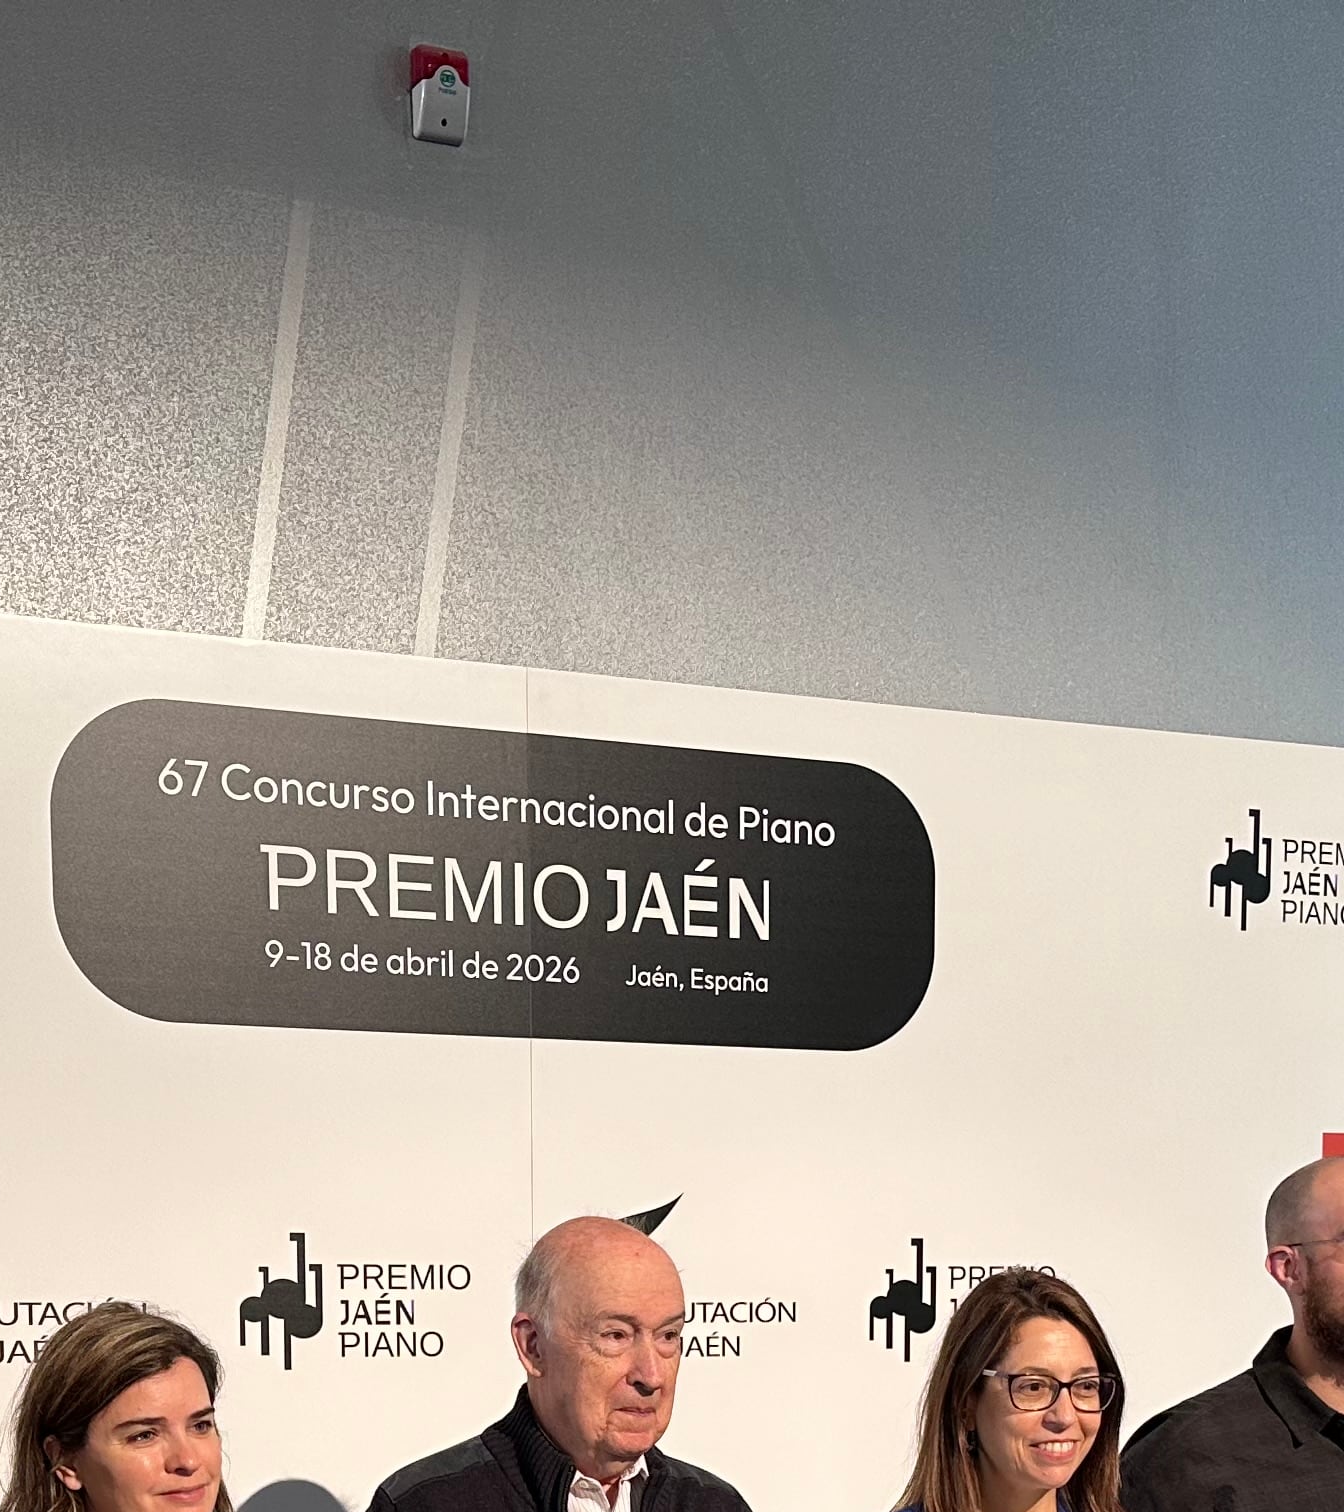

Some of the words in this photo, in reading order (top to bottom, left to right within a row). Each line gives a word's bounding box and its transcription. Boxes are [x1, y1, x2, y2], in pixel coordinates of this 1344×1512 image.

[158, 758, 209, 797] 67
[221, 763, 415, 814] Concurso
[426, 780, 675, 835] Internacional
[684, 802, 729, 839] de
[739, 806, 836, 847] Piano
[260, 844, 589, 929] PREMIO
[606, 858, 770, 941] JAÉN
[1282, 866, 1338, 897] JAÉN
[264, 939, 332, 971] 9-18
[340, 943, 378, 973] de
[386, 947, 454, 977] abril
[462, 950, 499, 980] de
[506, 953, 580, 983] 2026
[625, 964, 684, 991] Jaén,
[690, 967, 769, 996] España
[336, 1263, 471, 1290] PREMIO
[340, 1292, 415, 1326] JAÉN
[338, 1331, 444, 1358] PIANO
